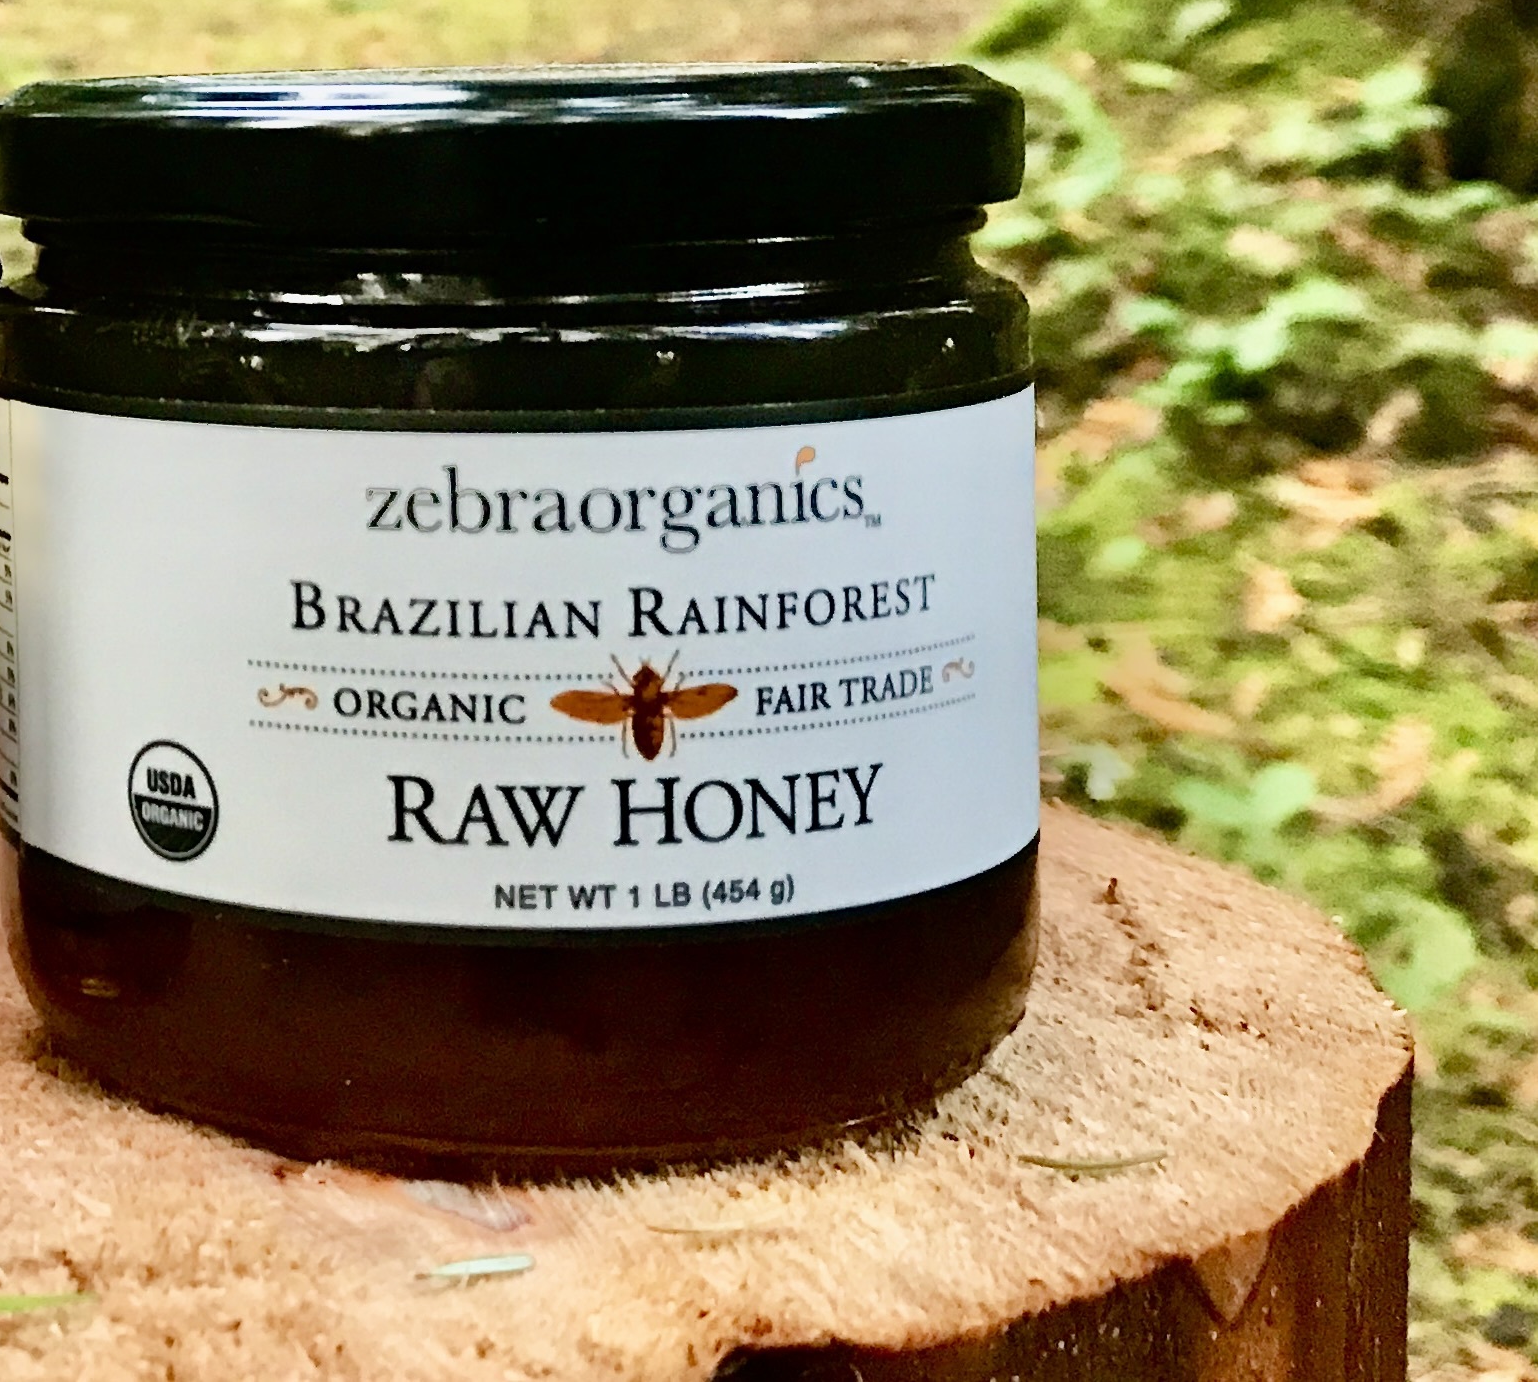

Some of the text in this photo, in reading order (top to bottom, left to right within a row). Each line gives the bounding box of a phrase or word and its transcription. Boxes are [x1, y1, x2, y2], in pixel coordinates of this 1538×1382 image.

[365, 445, 864, 555] zebraorganics
[289, 572, 936, 641] BRAZILIAN RAINFOREST
[332, 664, 934, 726] ORGANIC FAIR TRADE
[146, 765, 197, 800] USDA
[385, 761, 884, 849] RAW HONEY
[141, 800, 205, 833] ORGANIC
[493, 873, 796, 912] NET WT 1 LB (454 g)
